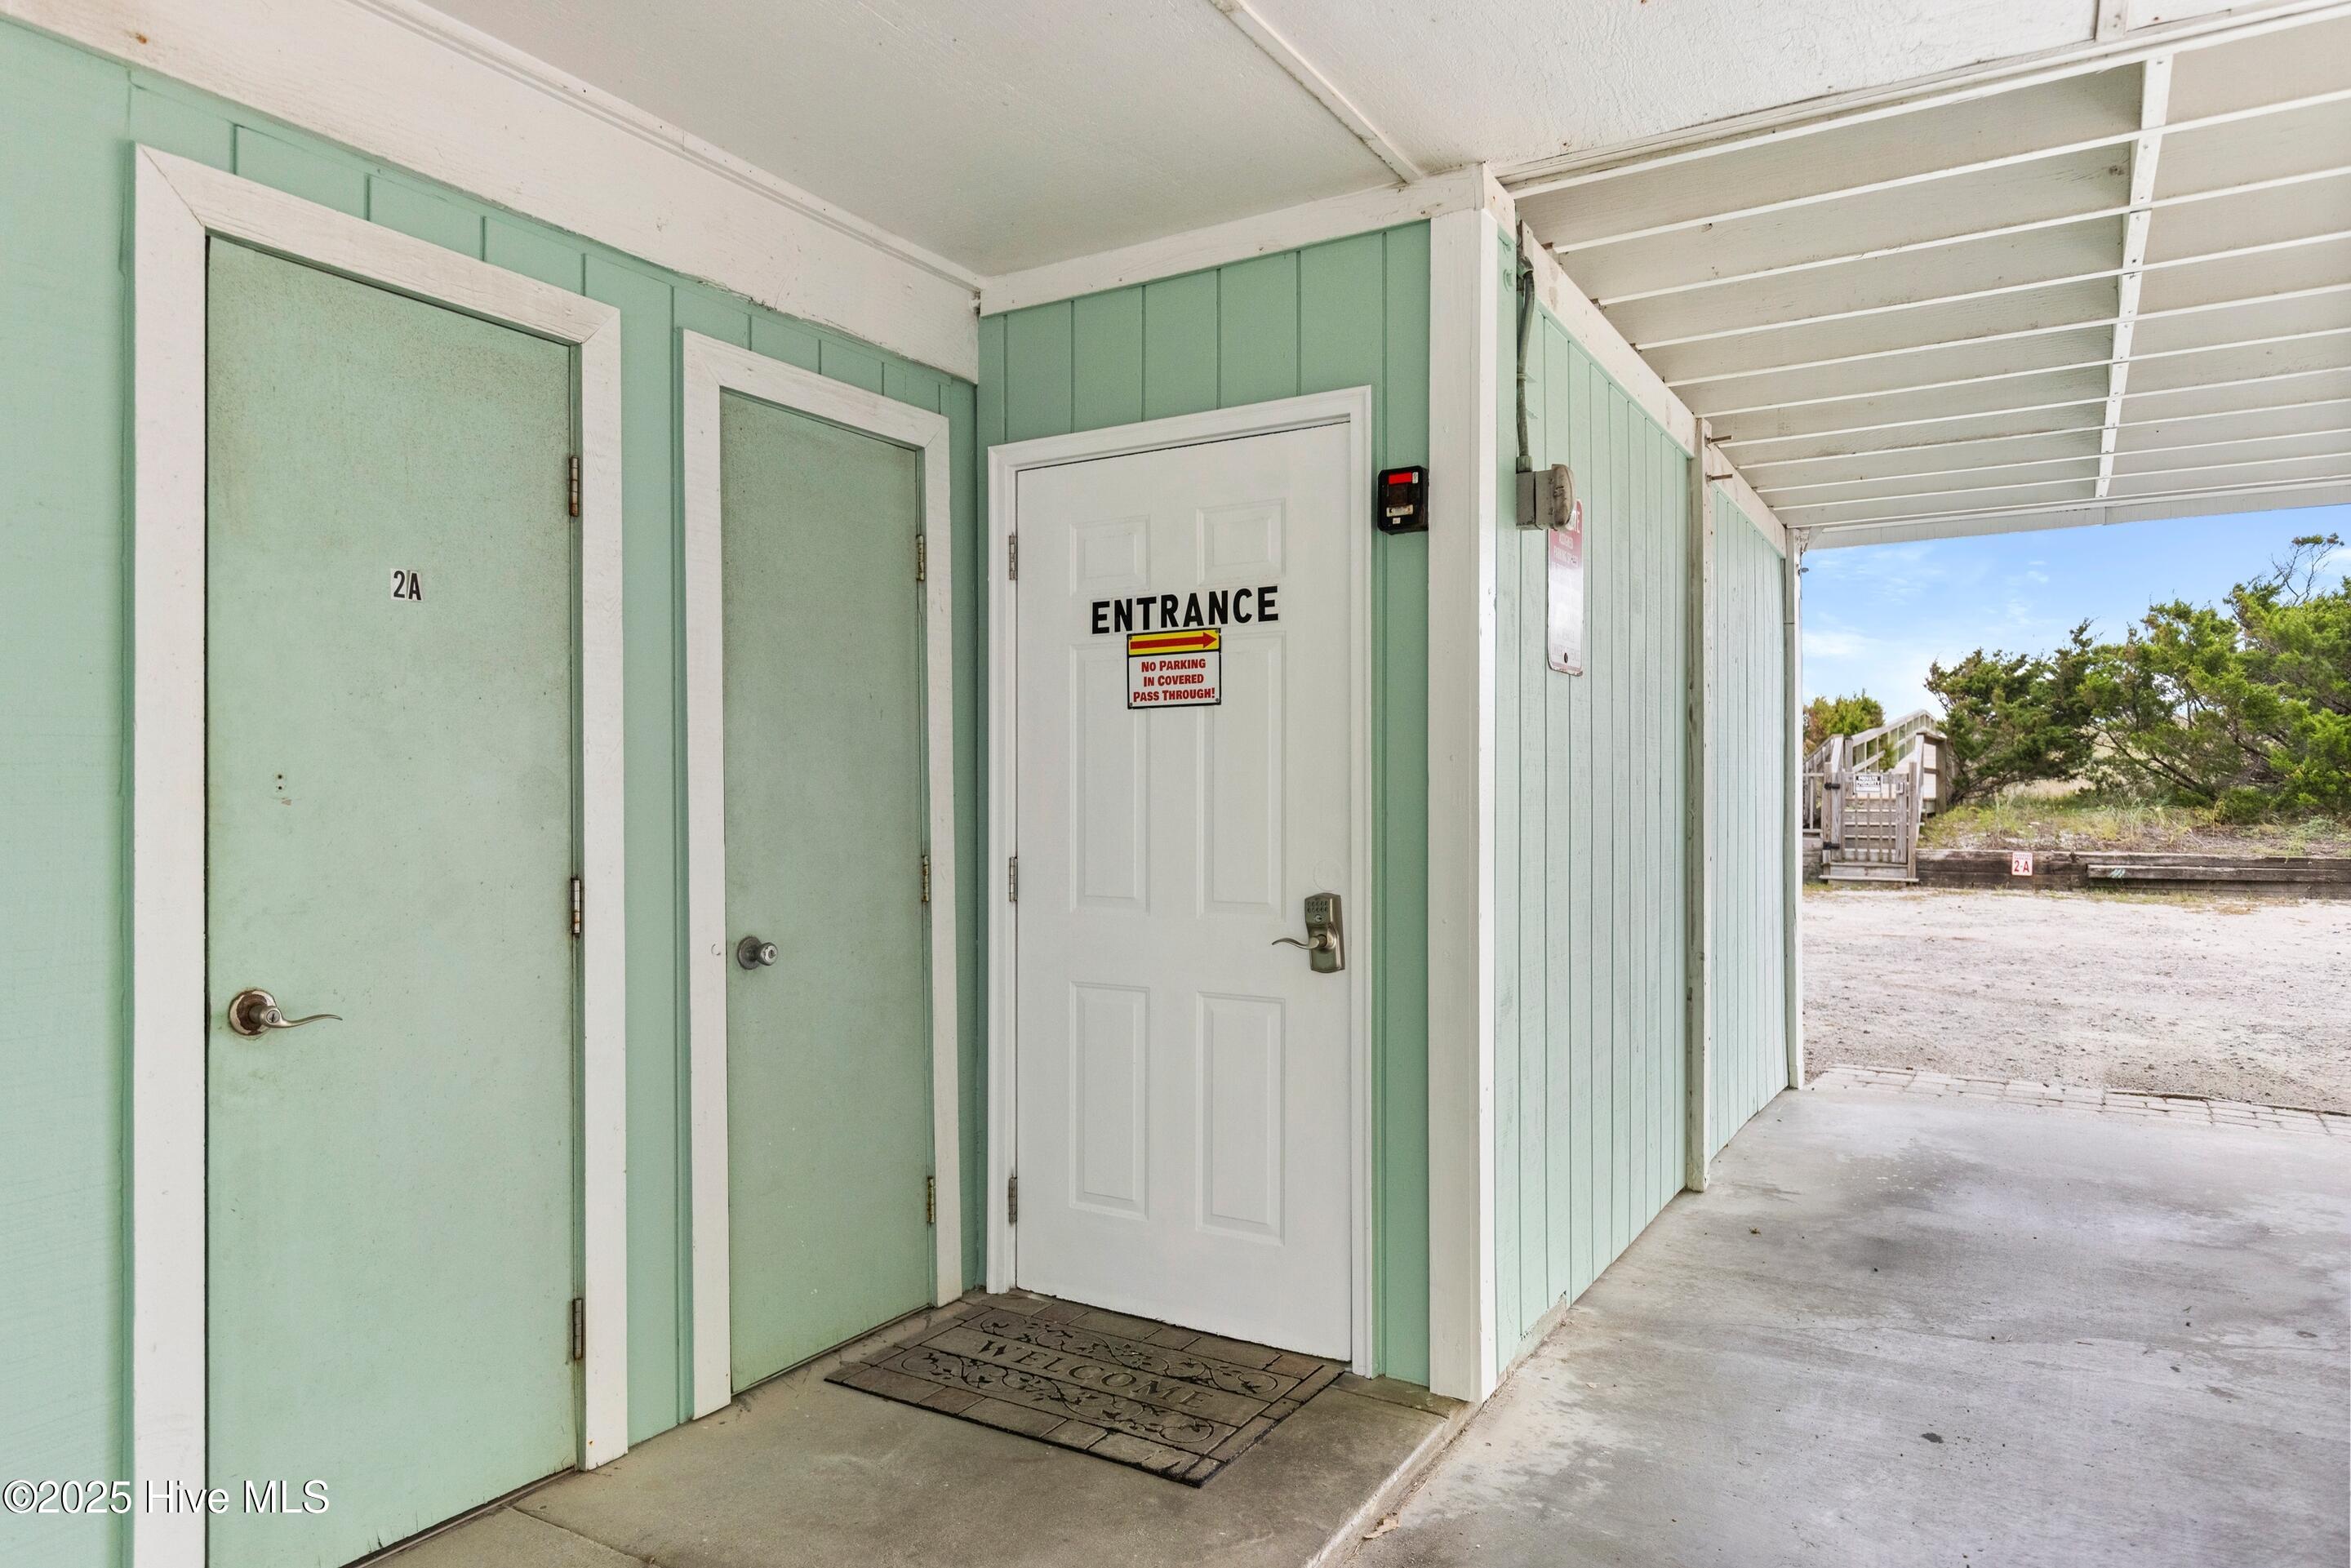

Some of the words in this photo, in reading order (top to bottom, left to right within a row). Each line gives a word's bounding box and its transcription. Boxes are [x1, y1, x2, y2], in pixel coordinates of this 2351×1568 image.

[393, 571, 421, 601] 2A
[1091, 585, 1279, 634] ENTRANCE
[1141, 662, 1156, 673] NO
[1159, 659, 1206, 671] PARKING
[1144, 677, 1154, 686] IN
[1158, 674, 1204, 686] COVERED
[1133, 691, 1159, 702] PASS
[1162, 687, 1215, 700] THROUGH!
[979, 1339, 1213, 1408] WELCOME
